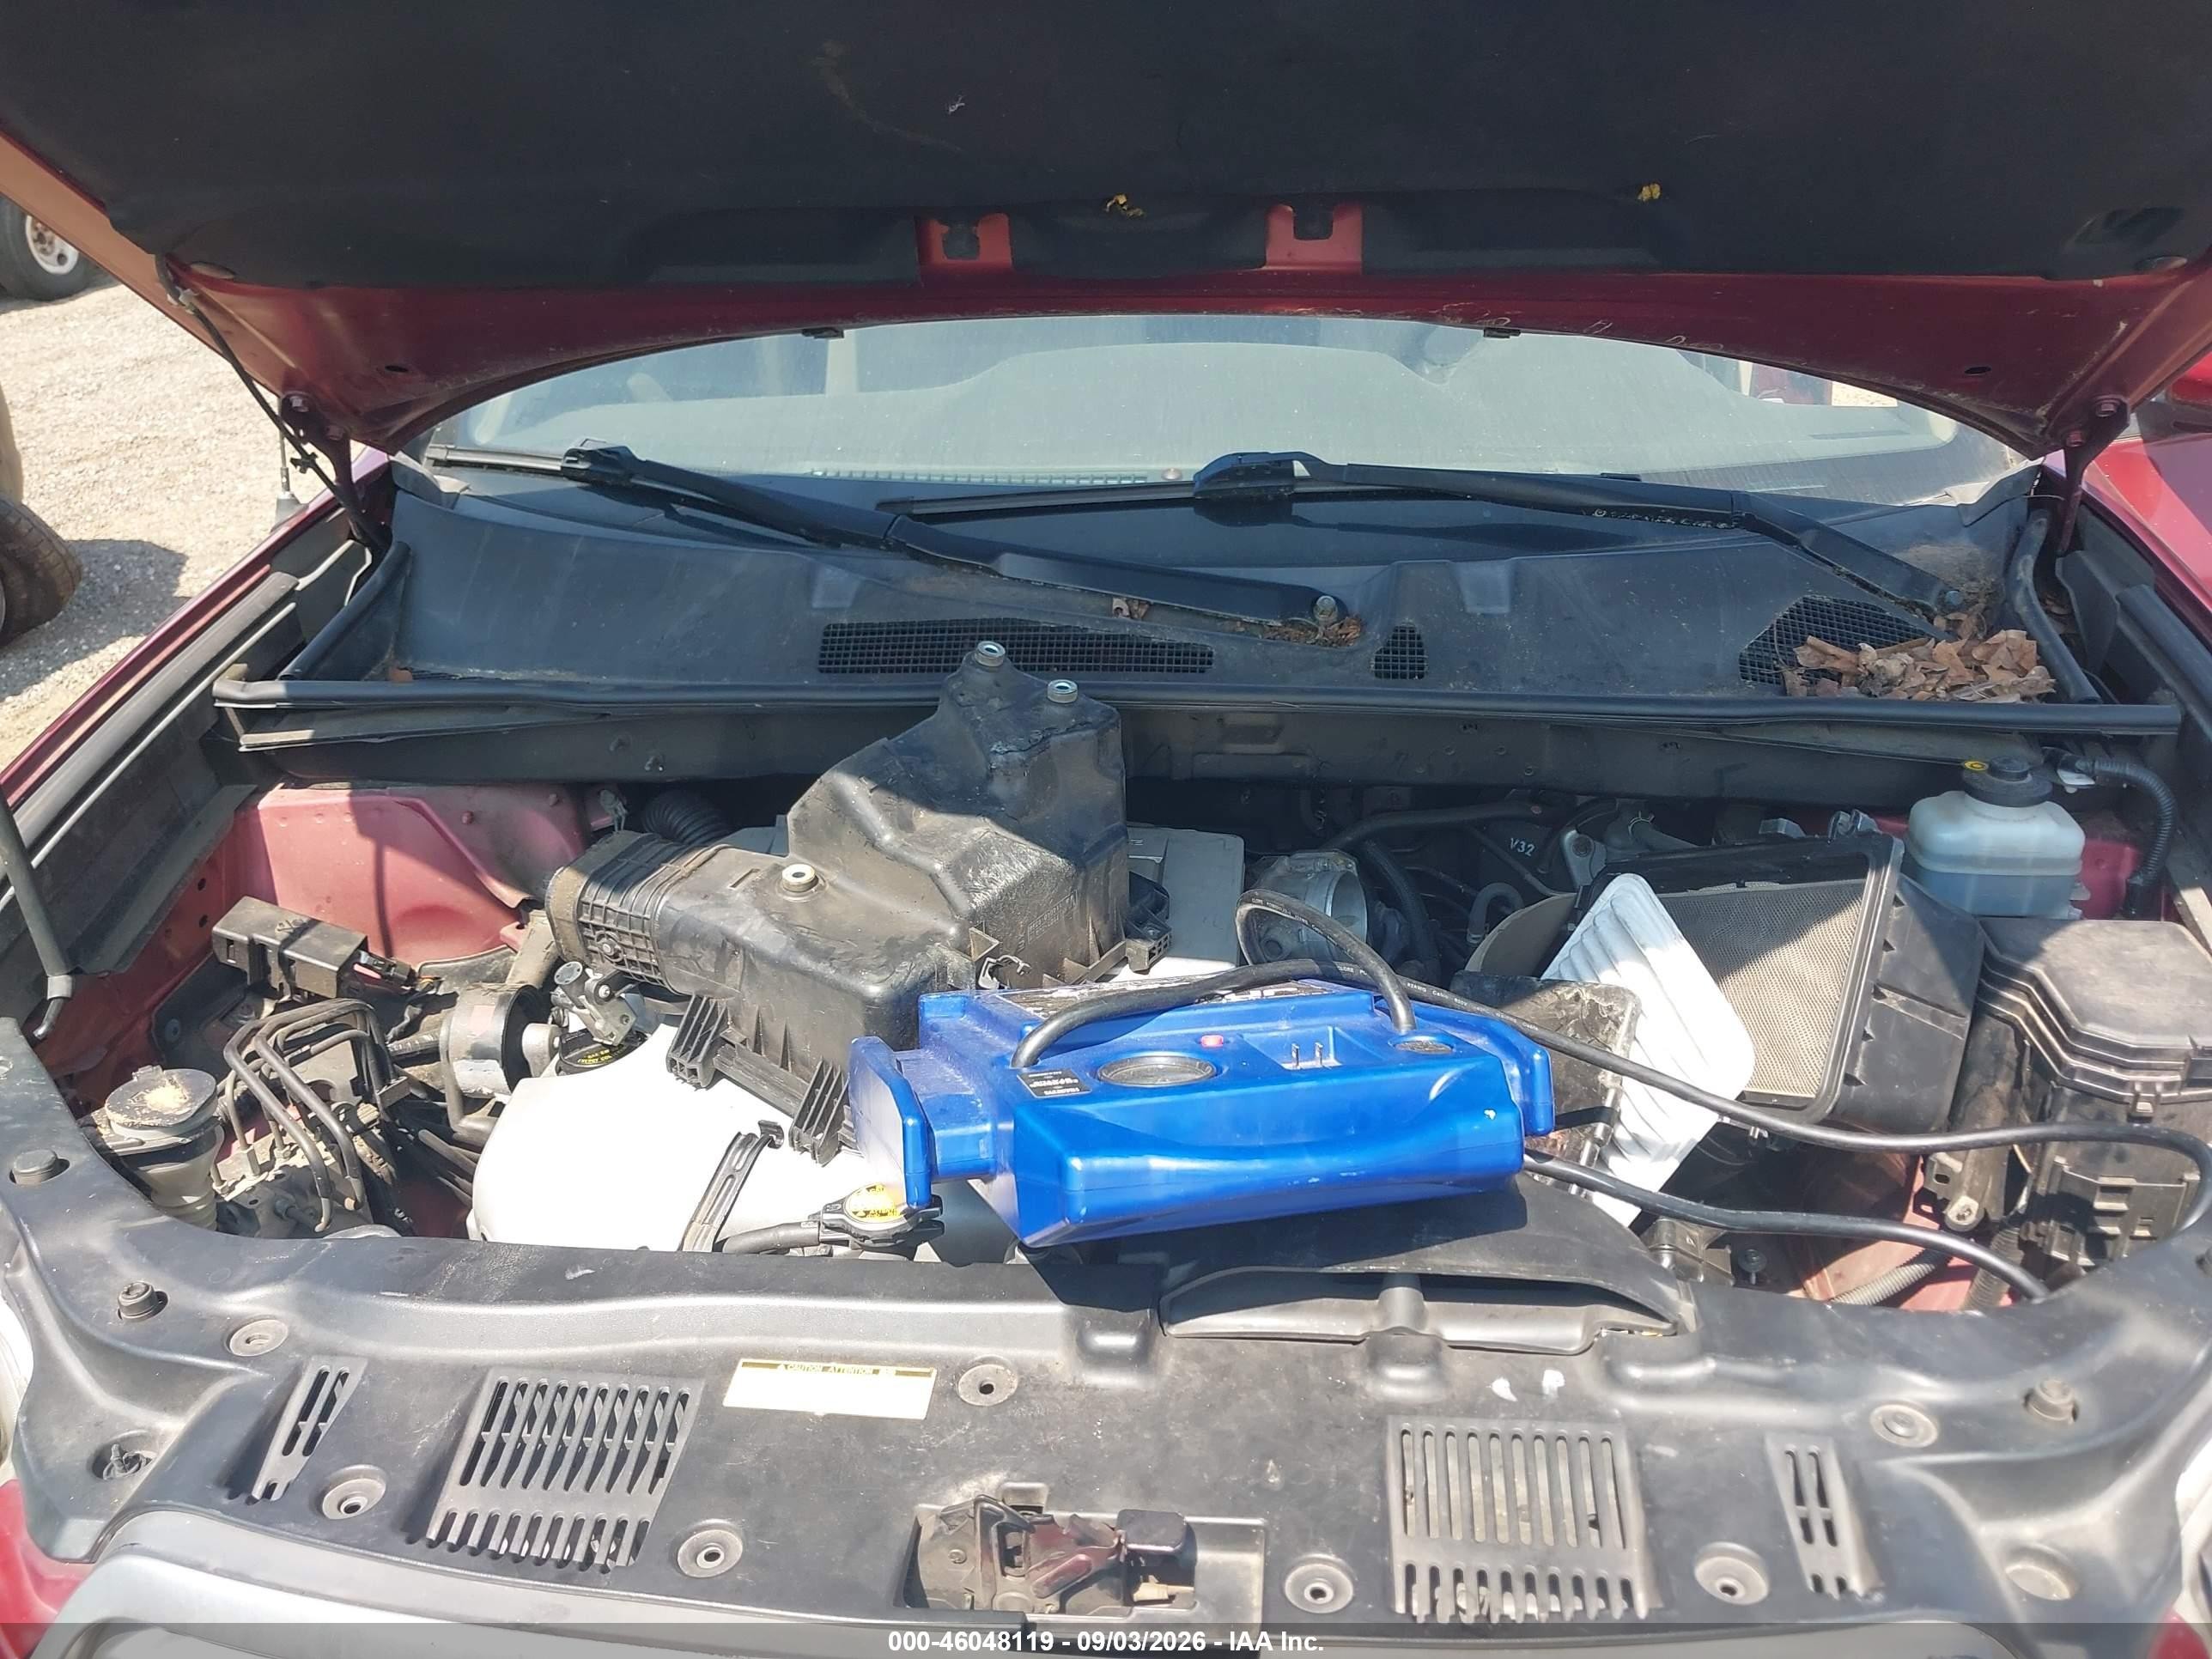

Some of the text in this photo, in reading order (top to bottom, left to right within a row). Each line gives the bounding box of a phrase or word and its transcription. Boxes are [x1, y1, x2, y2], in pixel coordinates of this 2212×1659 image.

[1510, 837, 1535, 857] V32
[787, 1363, 823, 1373] CAUTION
[828, 1364, 873, 1375] ATTENTION
